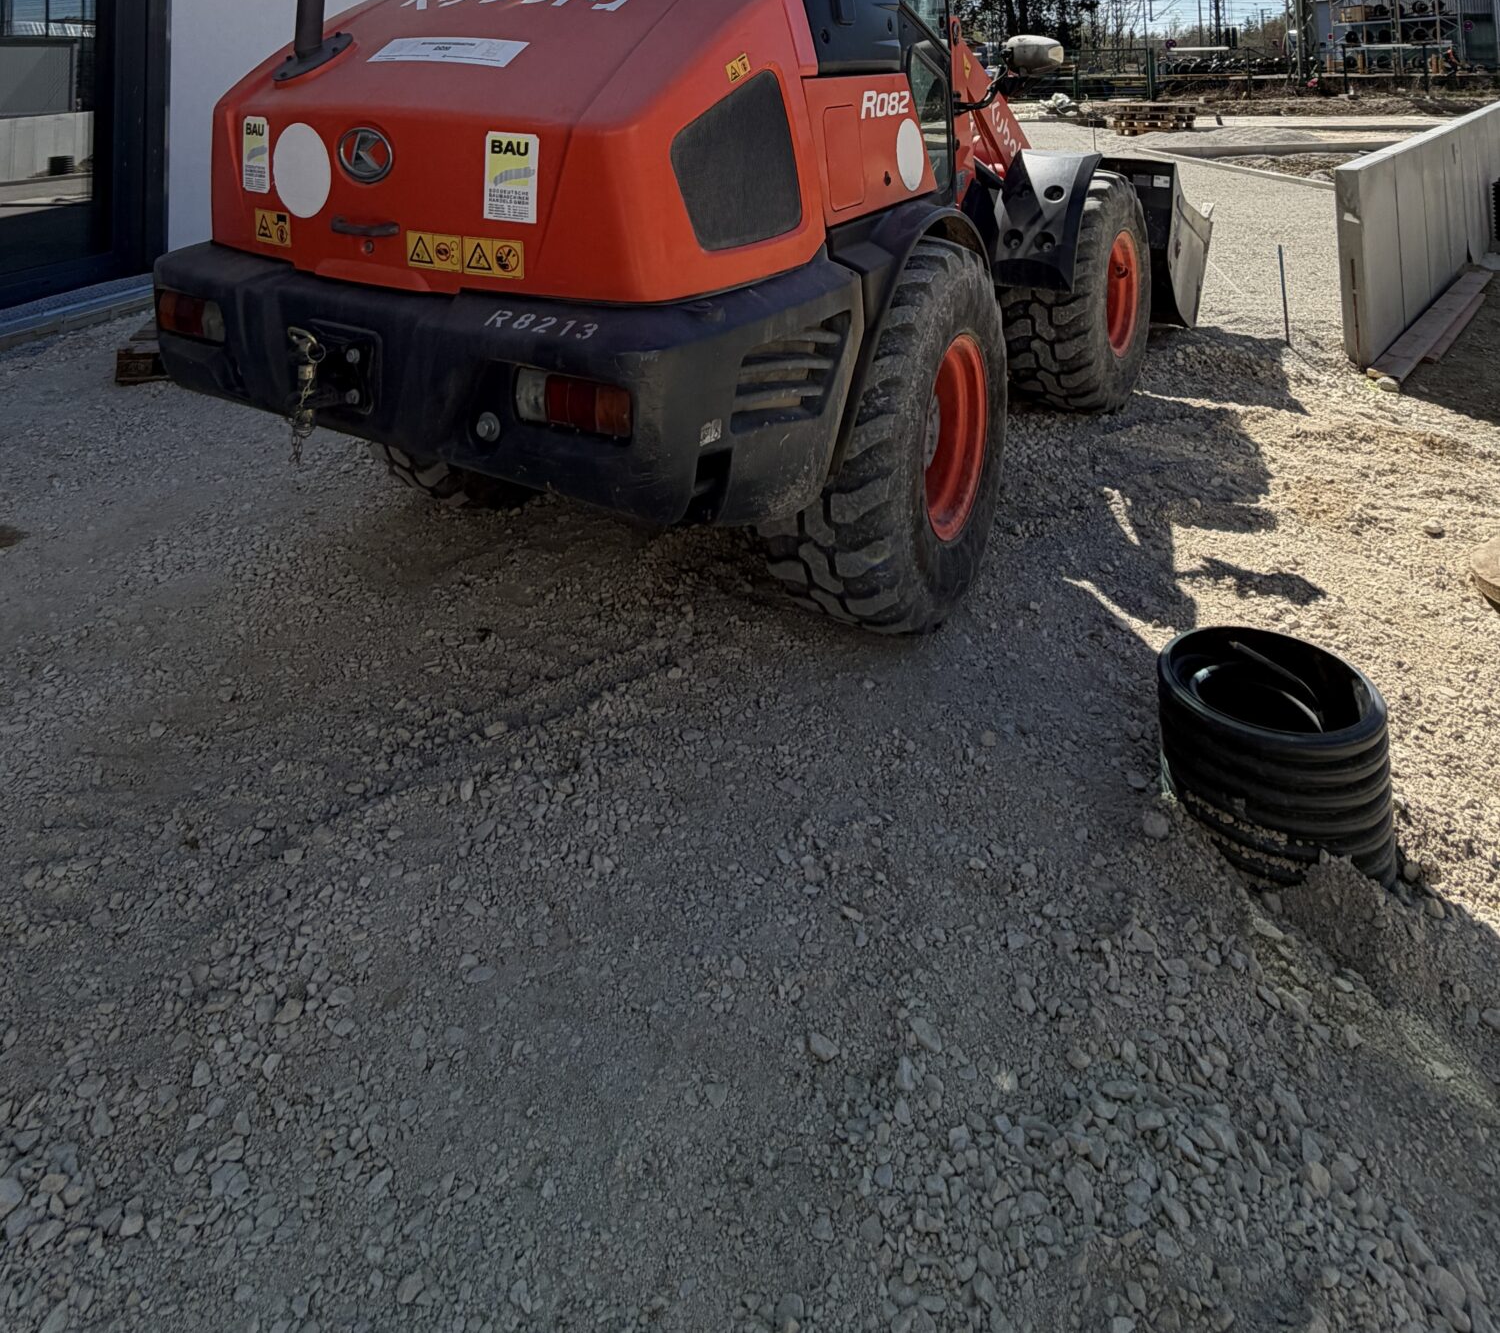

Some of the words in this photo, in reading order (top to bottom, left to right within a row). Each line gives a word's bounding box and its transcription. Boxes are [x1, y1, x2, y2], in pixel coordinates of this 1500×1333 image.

[860, 90, 910, 119] R082
[245, 122, 265, 137] BAU
[490, 139, 529, 157] BAU
[484, 309, 599, 340] R8213
